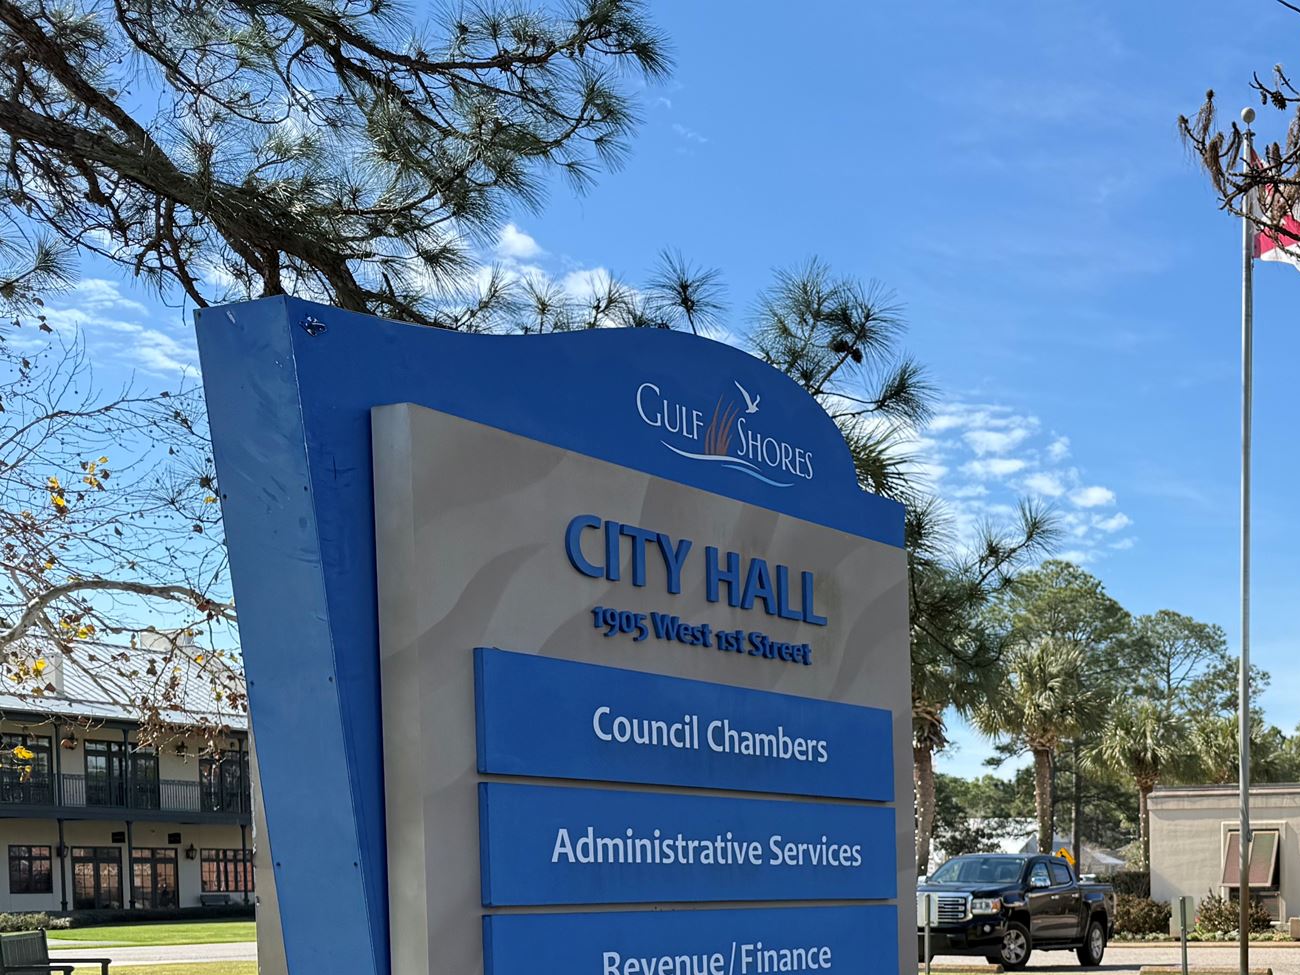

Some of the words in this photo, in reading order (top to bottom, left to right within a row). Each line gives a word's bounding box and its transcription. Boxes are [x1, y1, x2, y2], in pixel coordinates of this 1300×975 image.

[635, 382, 704, 440] GULF
[736, 416, 815, 481] SHORES
[565, 514, 693, 596] CITY
[704, 546, 828, 627] HALL
[591, 605, 649, 642] 1905
[650, 611, 712, 649] West
[716, 629, 746, 653] 1st
[748, 631, 813, 666] Street
[593, 706, 699, 750] Council
[707, 720, 828, 763] Chambers
[551, 827, 763, 866] Administrative
[769, 835, 862, 867] Services
